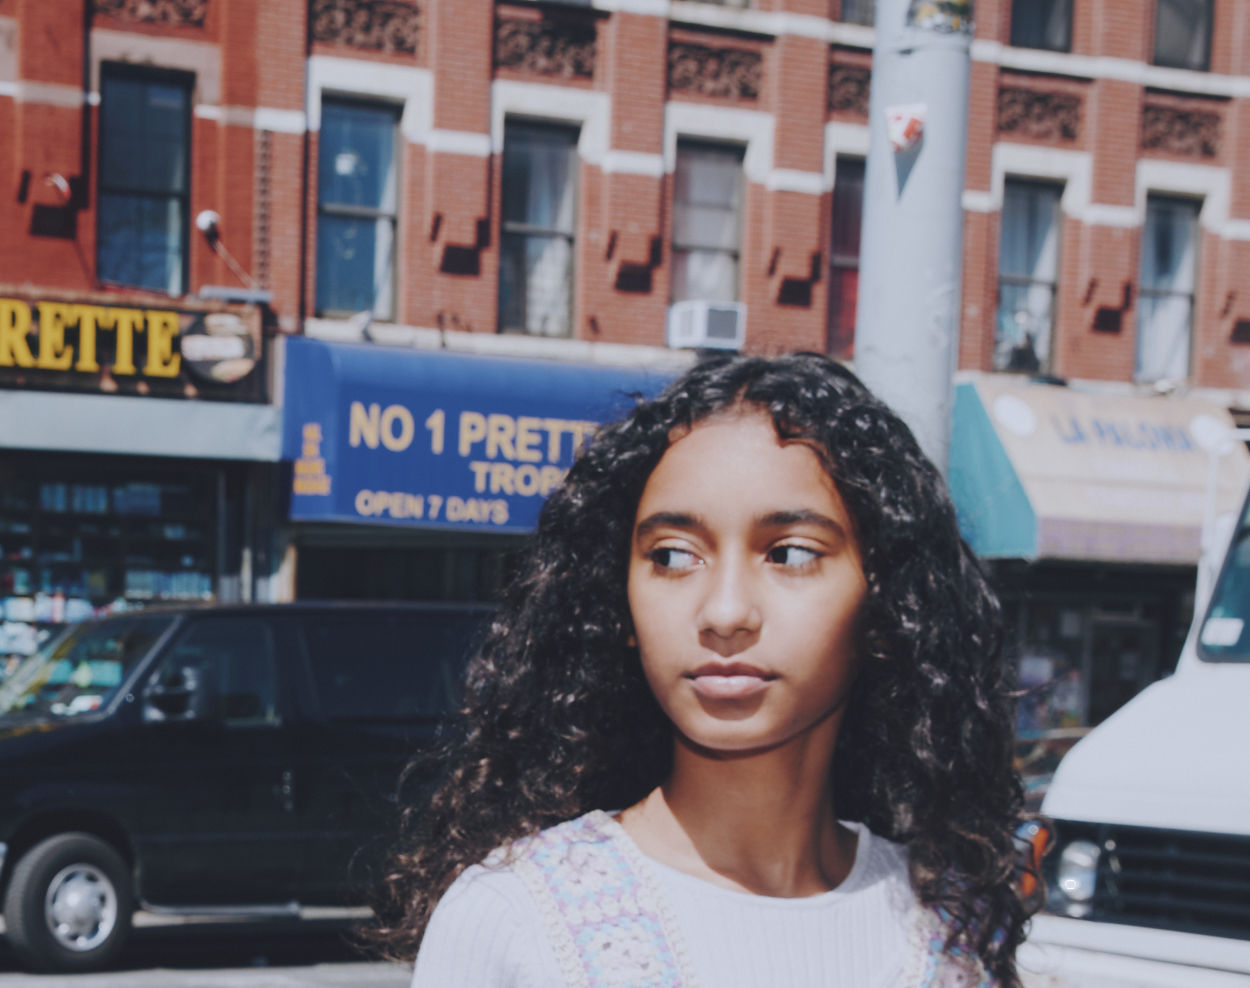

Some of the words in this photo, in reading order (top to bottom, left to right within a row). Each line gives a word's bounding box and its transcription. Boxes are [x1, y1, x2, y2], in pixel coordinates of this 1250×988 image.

[349, 400, 415, 452] NO
[424, 408, 445, 455] 1
[469, 460, 571, 497] TROP
[354, 488, 424, 519] OPEN
[427, 494, 444, 521] 7
[445, 495, 510, 526] DAYS
